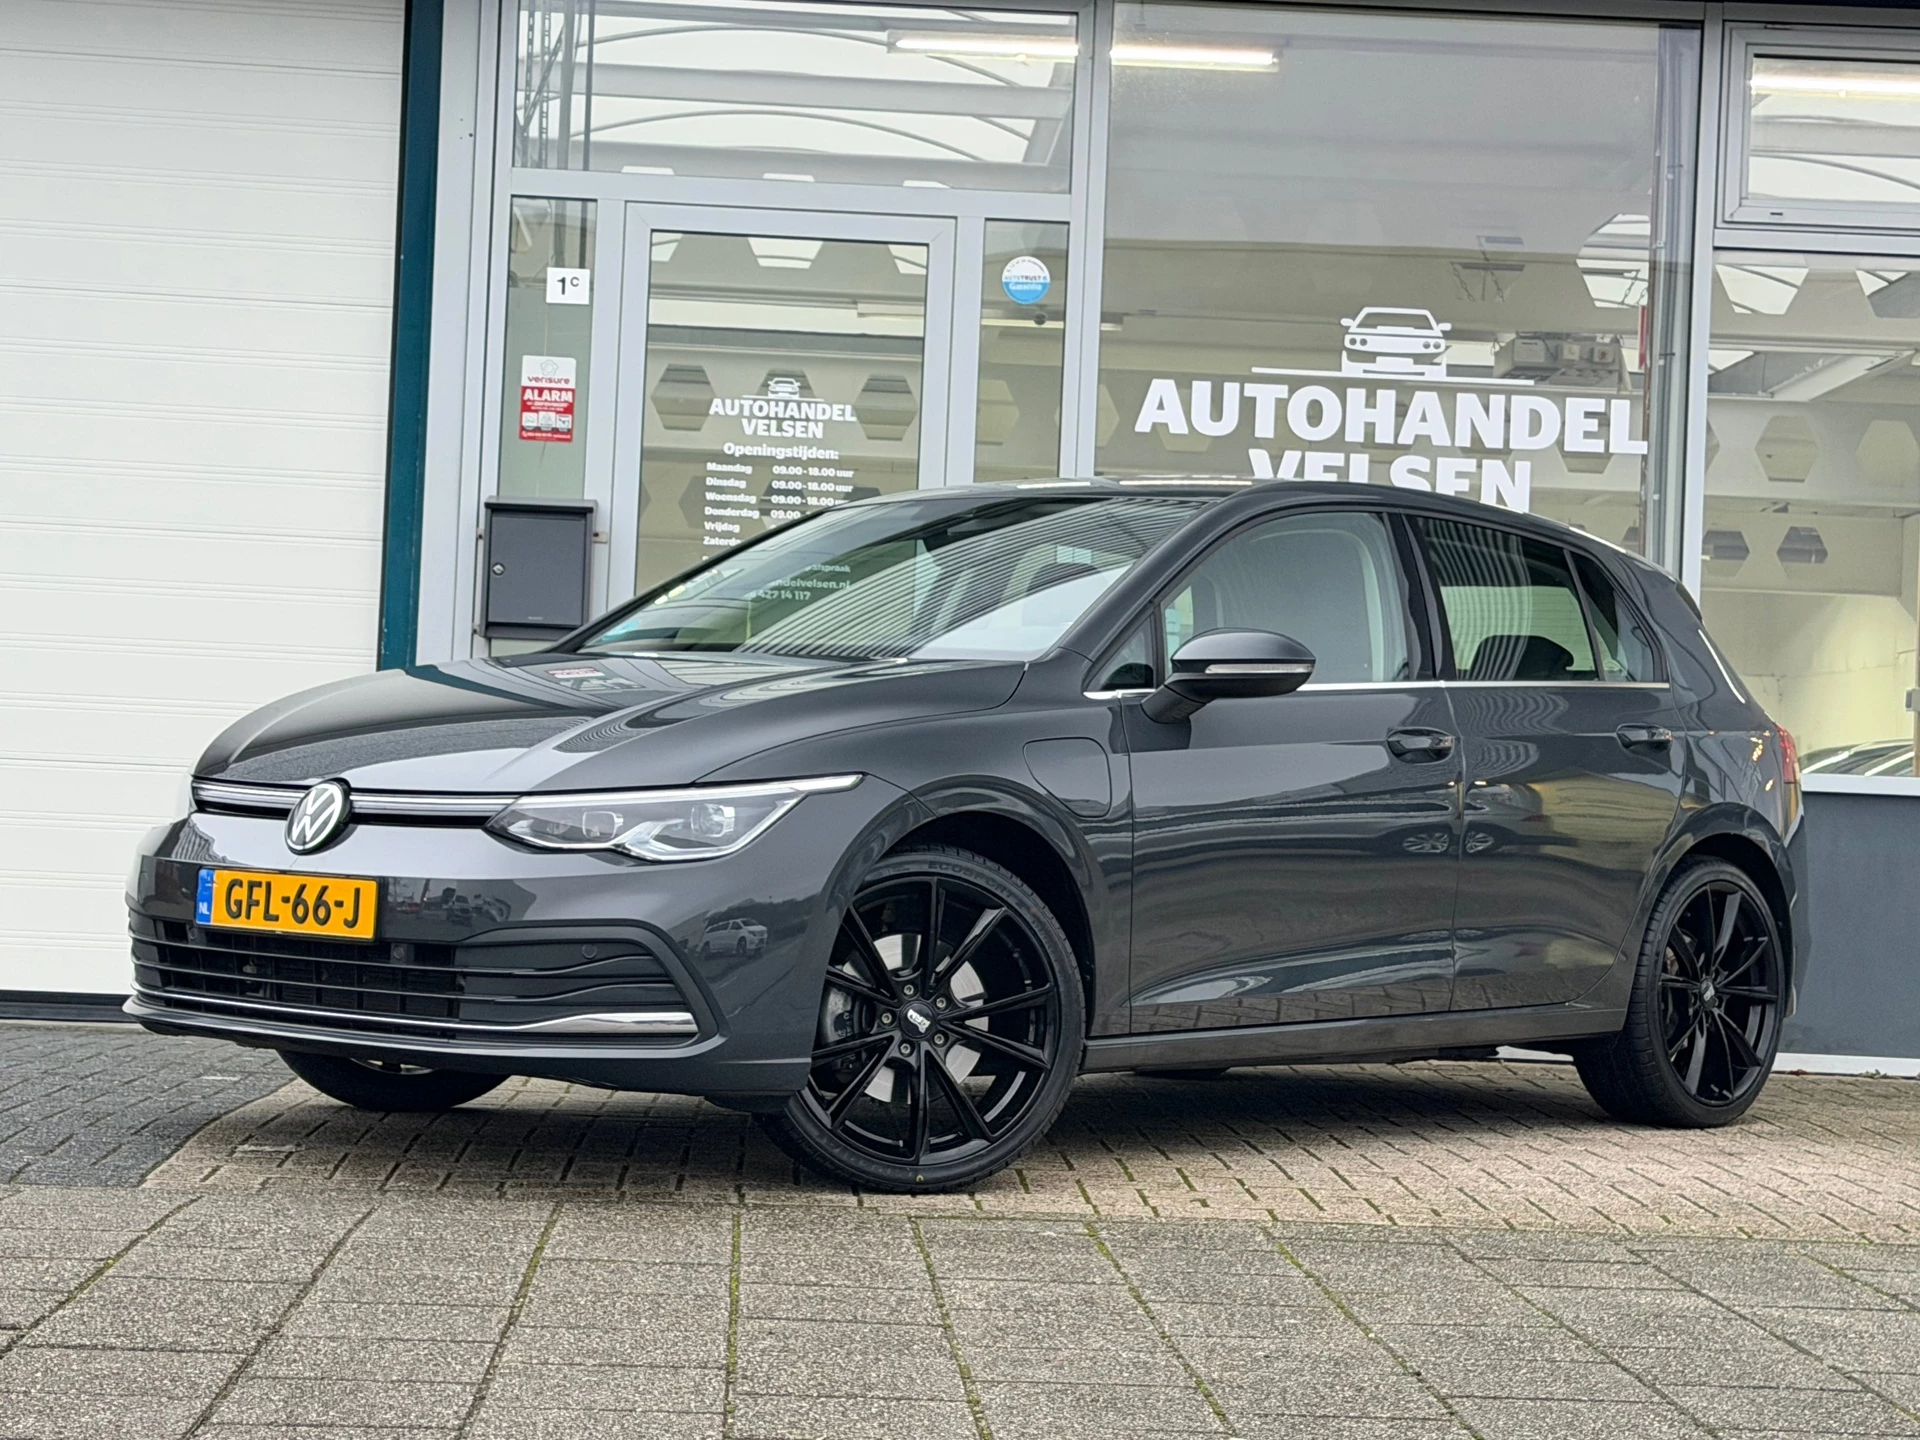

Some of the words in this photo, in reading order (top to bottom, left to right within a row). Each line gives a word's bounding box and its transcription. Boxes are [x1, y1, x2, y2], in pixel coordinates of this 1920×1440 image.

[527, 376, 571, 385] verisure
[523, 388, 573, 403] ALARM
[709, 398, 857, 421] AUTOHANDEL
[1135, 378, 1648, 455] AUTOHANDEL
[741, 418, 824, 438] VELSEN
[723, 442, 839, 460] Openingstijden:
[706, 462, 753, 475] Maandag
[836, 470, 855, 478] uur
[705, 477, 747, 489] Dinsdag
[704, 492, 757, 504] Woensdag
[704, 506, 760, 519] Donderdag
[703, 521, 740, 533] Vrijdag
[702, 536, 742, 546] Zaterda
[794, 591, 811, 600] 117
[199, 902, 210, 914] NL
[225, 878, 361, 929] GFL-66-J
